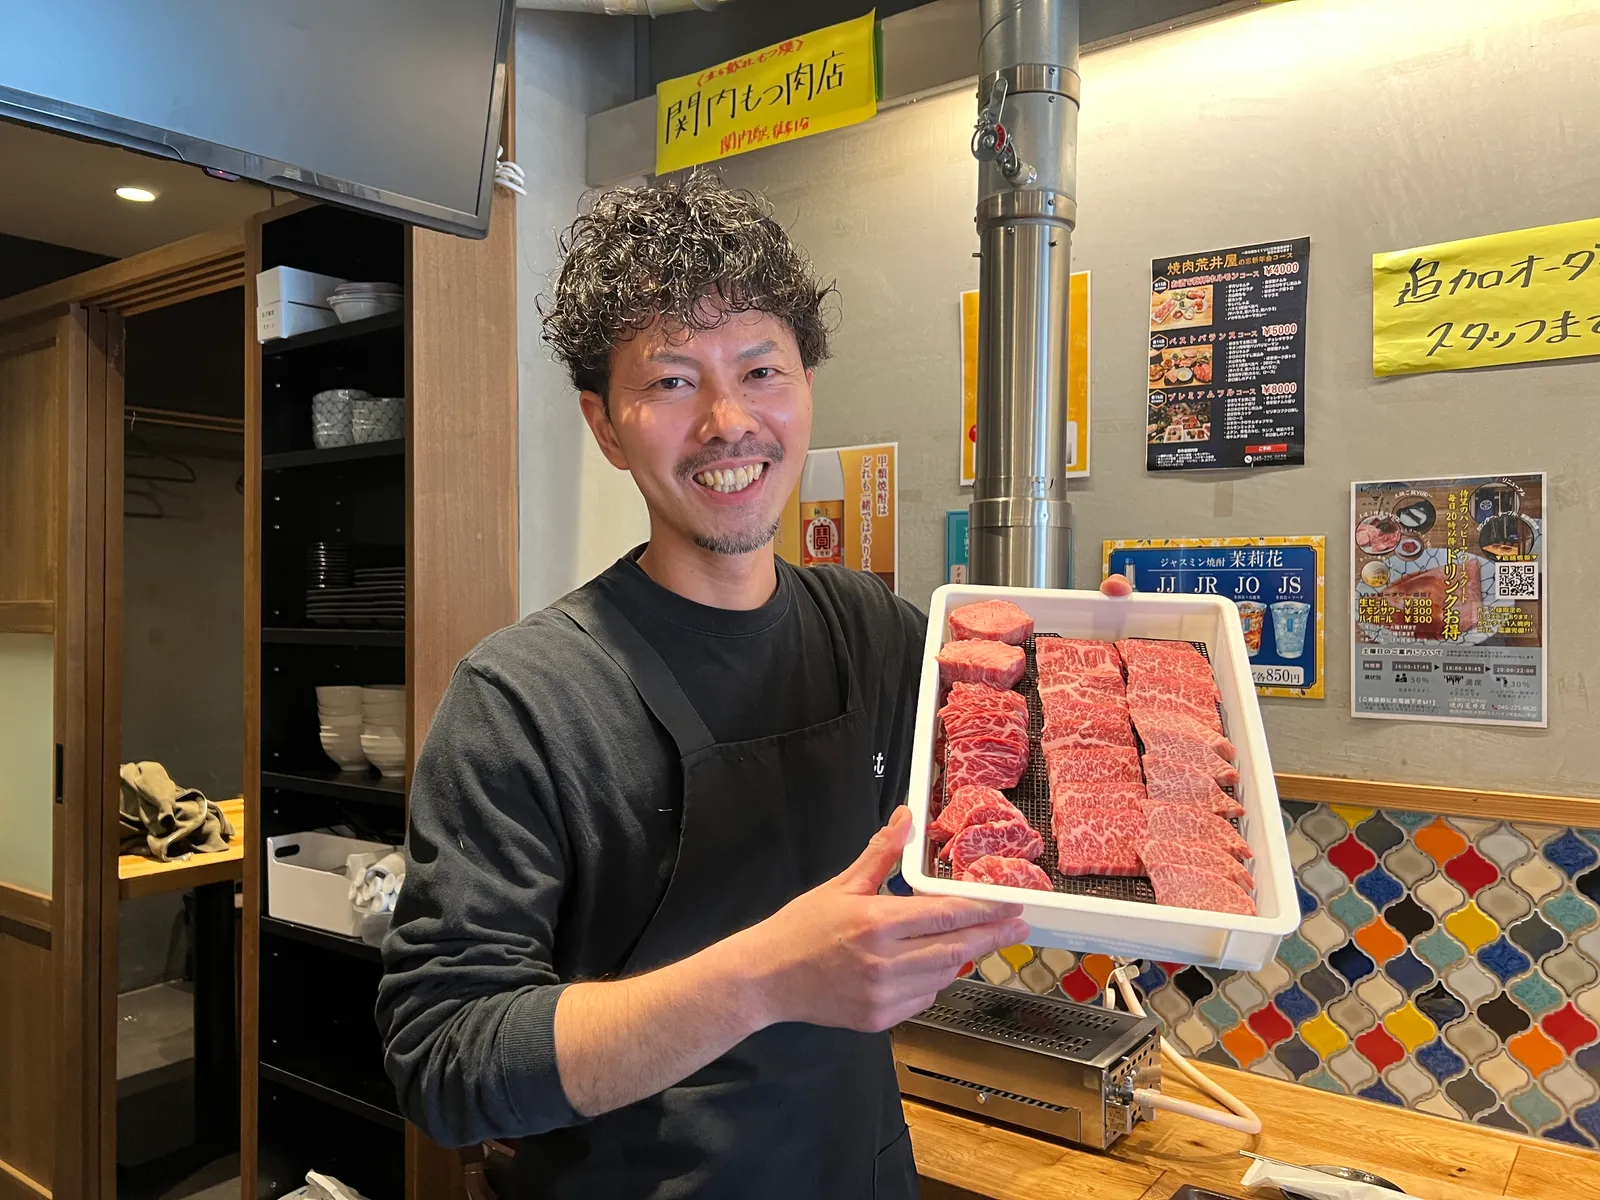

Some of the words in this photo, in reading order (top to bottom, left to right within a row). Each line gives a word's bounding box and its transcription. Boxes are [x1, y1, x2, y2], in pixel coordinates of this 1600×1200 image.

[666, 50, 847, 144] 関内もつ肉店
[1263, 262, 1299, 277] ¥4000
[1169, 330, 1258, 345] ベストバランスコース
[1262, 323, 1298, 338] ¥5000
[1167, 389, 1257, 405] プレミアムフルコース
[1262, 382, 1298, 396] ¥8000
[876, 454, 889, 517] 甲類焼酎は
[1160, 556, 1226, 568] ジャスミン焼酎
[1229, 549, 1283, 567] 茉莉花
[1156, 576, 1177, 594] JJ
[1193, 576, 1218, 594] JR
[1234, 576, 1260, 594] JO
[1278, 576, 1302, 594] JS
[1359, 598, 1389, 607] 生ビール
[1359, 606, 1402, 616] レモンサワー
[1359, 615, 1394, 624] ハイボール
[1361, 647, 1443, 657] 土曜日のご案内について
